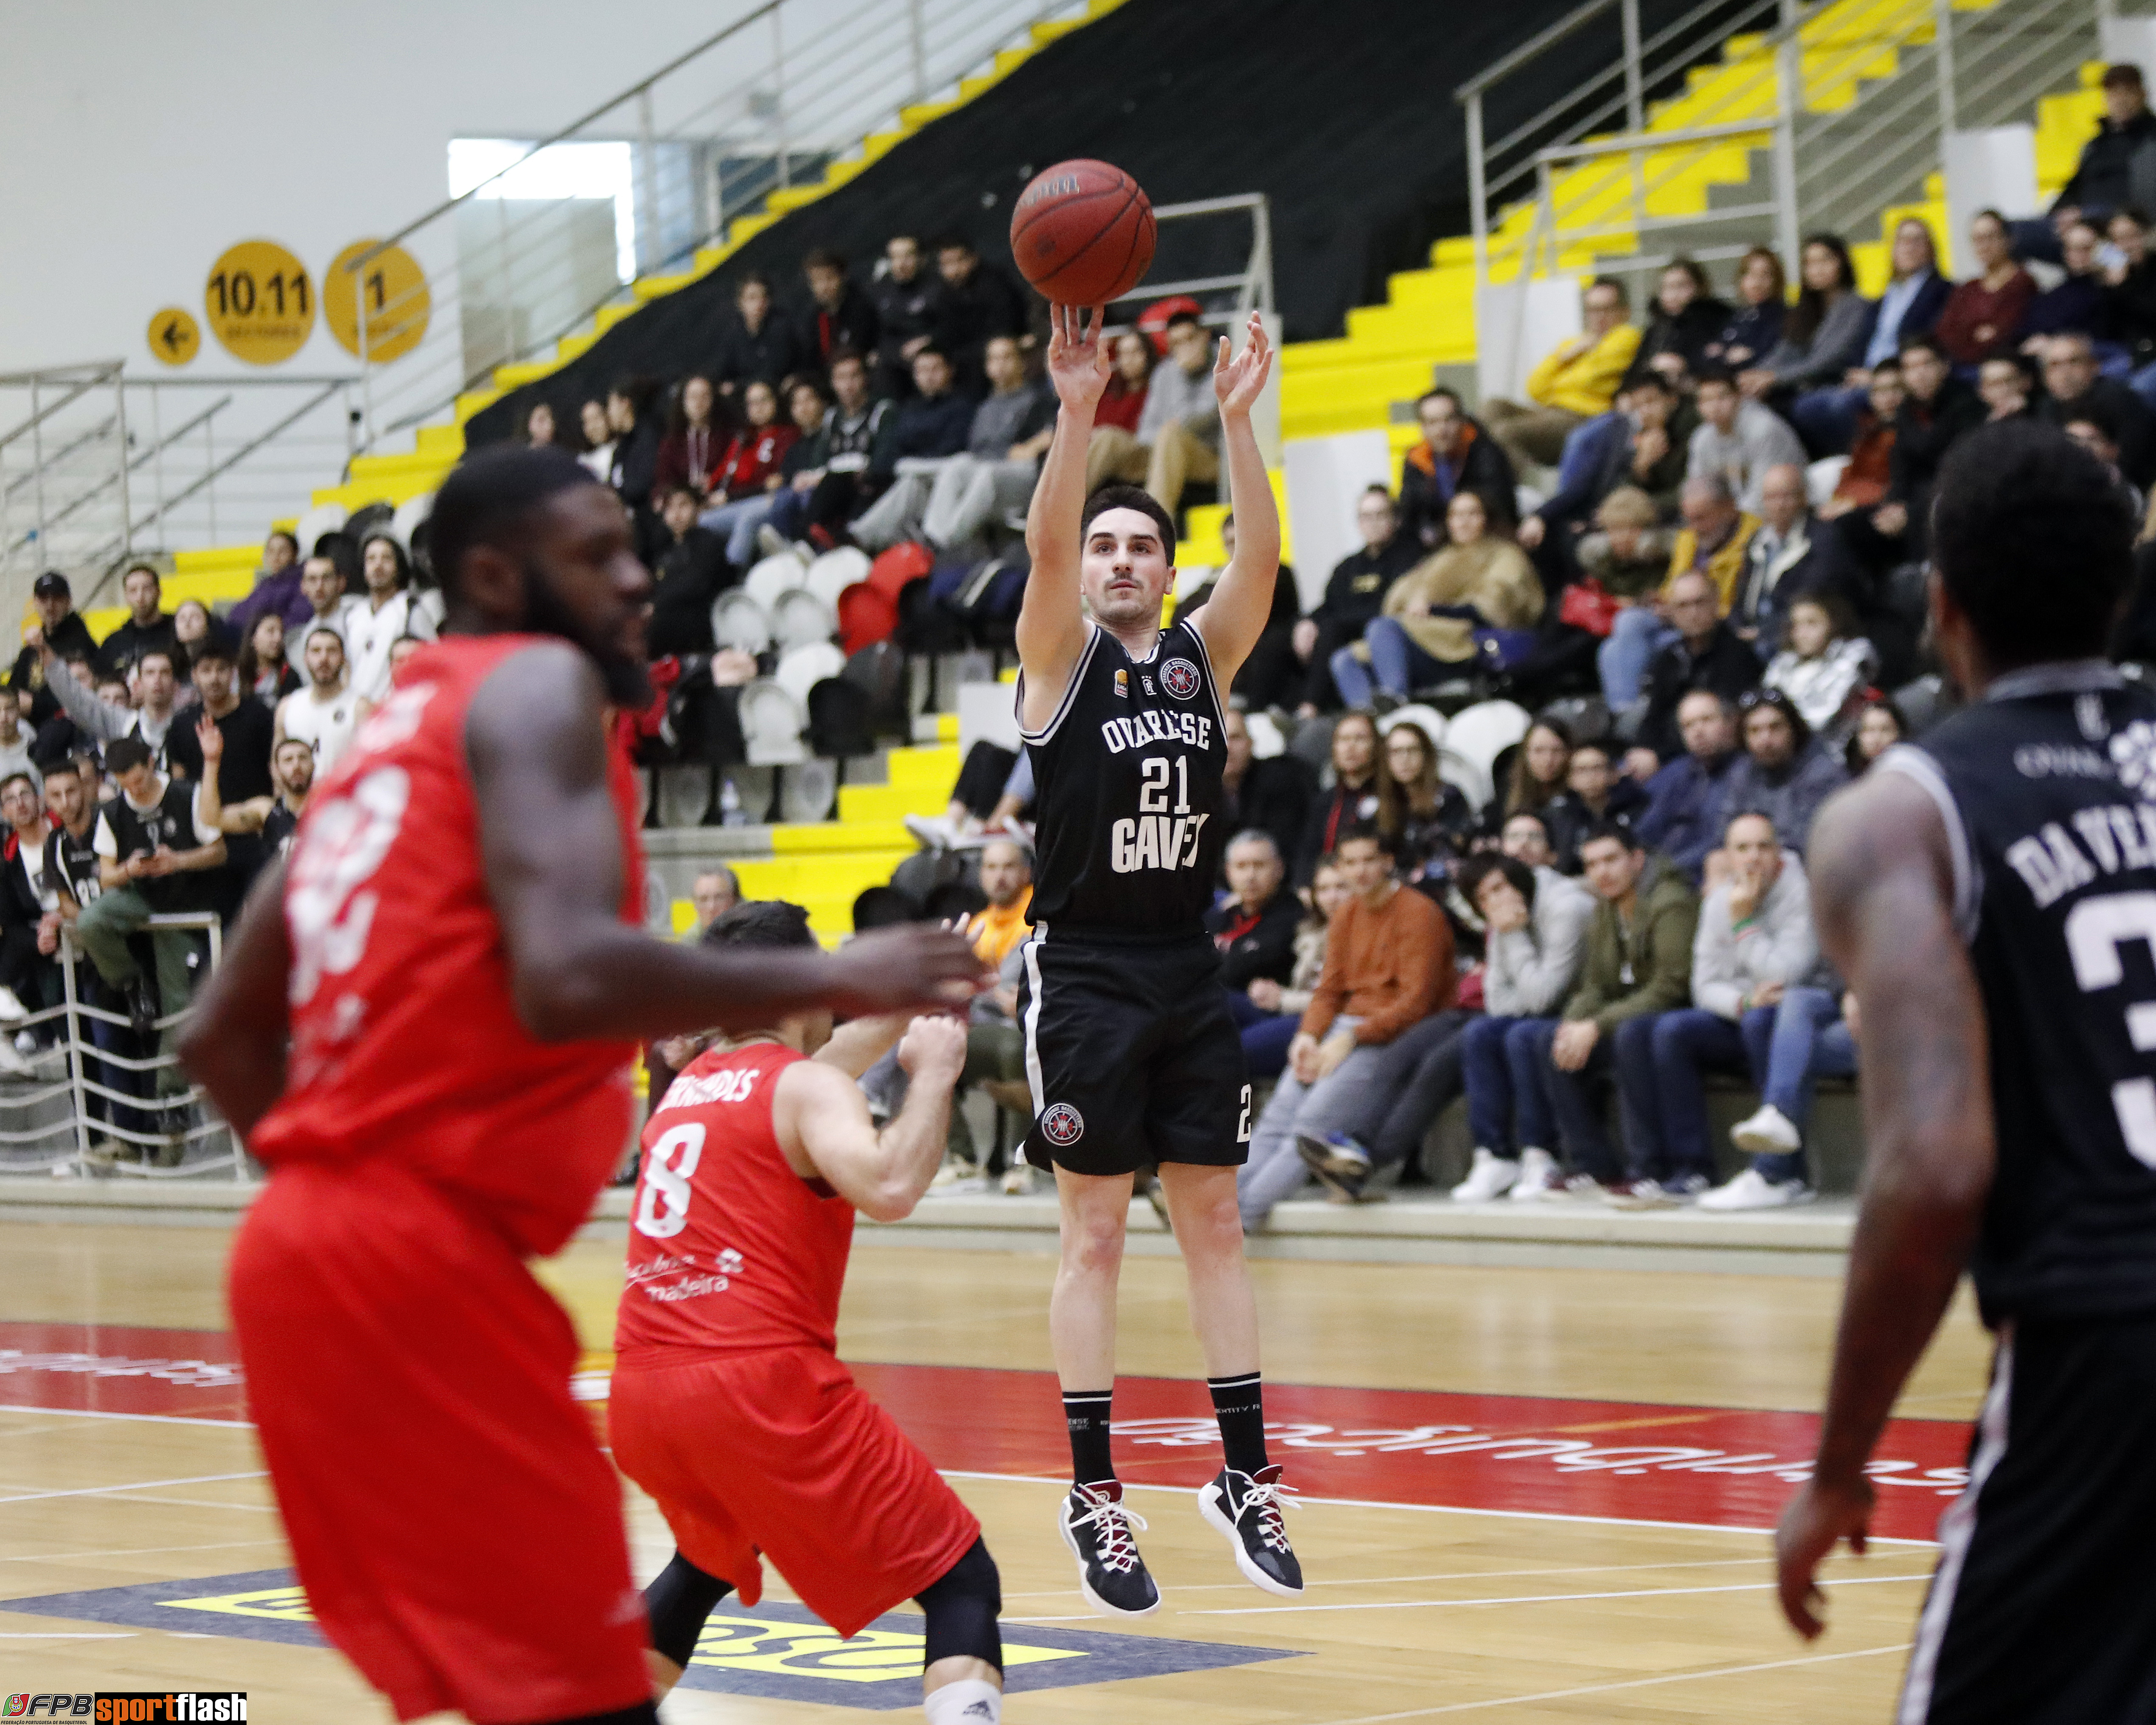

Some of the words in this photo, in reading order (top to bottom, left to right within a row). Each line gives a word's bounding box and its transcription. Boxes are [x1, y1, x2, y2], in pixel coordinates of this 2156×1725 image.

[211, 270, 308, 316] 10.11
[1139, 755, 1190, 814] 21
[635, 1122, 706, 1238] 8
